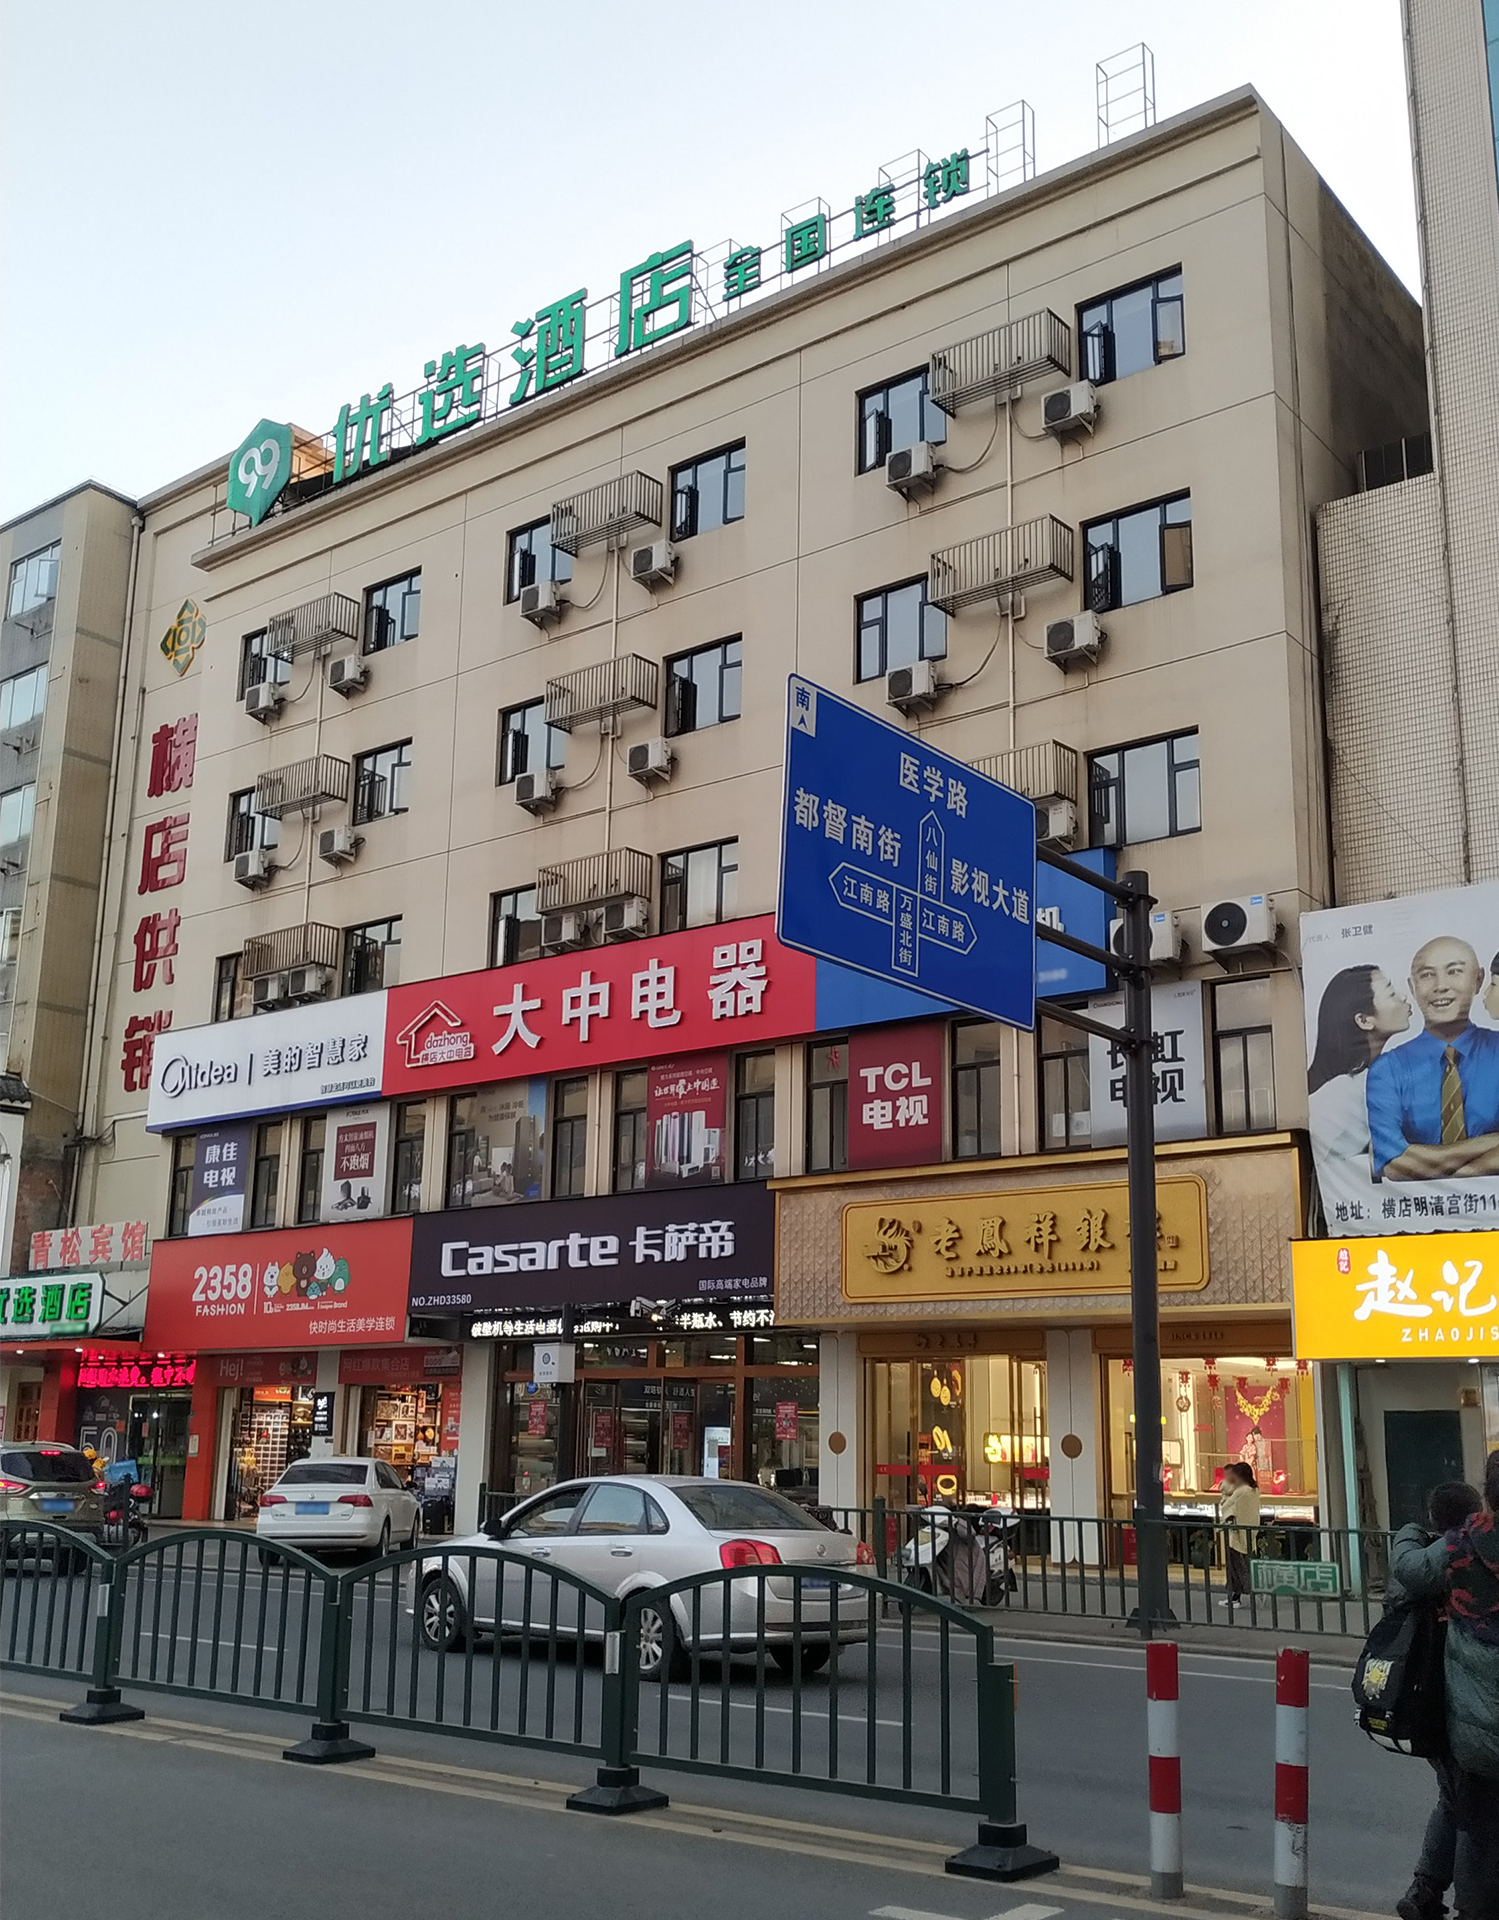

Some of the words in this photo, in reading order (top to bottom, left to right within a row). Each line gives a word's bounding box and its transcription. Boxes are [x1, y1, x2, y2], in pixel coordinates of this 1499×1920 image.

[333, 239, 695, 483] 优选酒店
[722, 148, 970, 302] 全国连锁
[238, 438, 280, 498] 99
[795, 686, 811, 711] 南
[900, 752, 968, 818] 医学路
[793, 787, 901, 867] 都督南街
[924, 826, 939, 896] 八仙街
[843, 874, 890, 914] 江南路
[950, 857, 1030, 925] 影视大道
[898, 894, 914, 967] 万盛北街
[921, 907, 966, 944] 江南路
[1341, 924, 1373, 939] 张卫健
[492, 938, 770, 1055] 大中电器
[426, 1031, 469, 1050] dazhong
[161, 1055, 238, 1098] Midea
[263, 1034, 368, 1077] 美的智慧家
[860, 1061, 932, 1093] TCL
[862, 1095, 929, 1130] 电视
[205, 1142, 238, 1164] 康佳
[203, 1166, 236, 1188] 电视
[1335, 1194, 1499, 1221] 地址：横店明清宫街11
[31, 1221, 146, 1268] 青松宾馆
[441, 1232, 619, 1277] Casarte
[629, 1220, 734, 1263] 卡萨帝
[930, 1207, 1162, 1260] 老鳳祥銀
[192, 1263, 252, 1301] 2358
[411, 1293, 472, 1307] NO.ZHD33580
[699, 1277, 767, 1291] 国际高端家电品牌
[1353, 1249, 1498, 1320] 赵记
[195, 1303, 245, 1316] FASHION
[309, 1316, 395, 1335] 快时尚生活美学连锁
[471, 1318, 563, 1337] 破壁机等生活电器
[220, 1359, 244, 1380] Hej!
[1257, 1564, 1335, 1592] 横店
